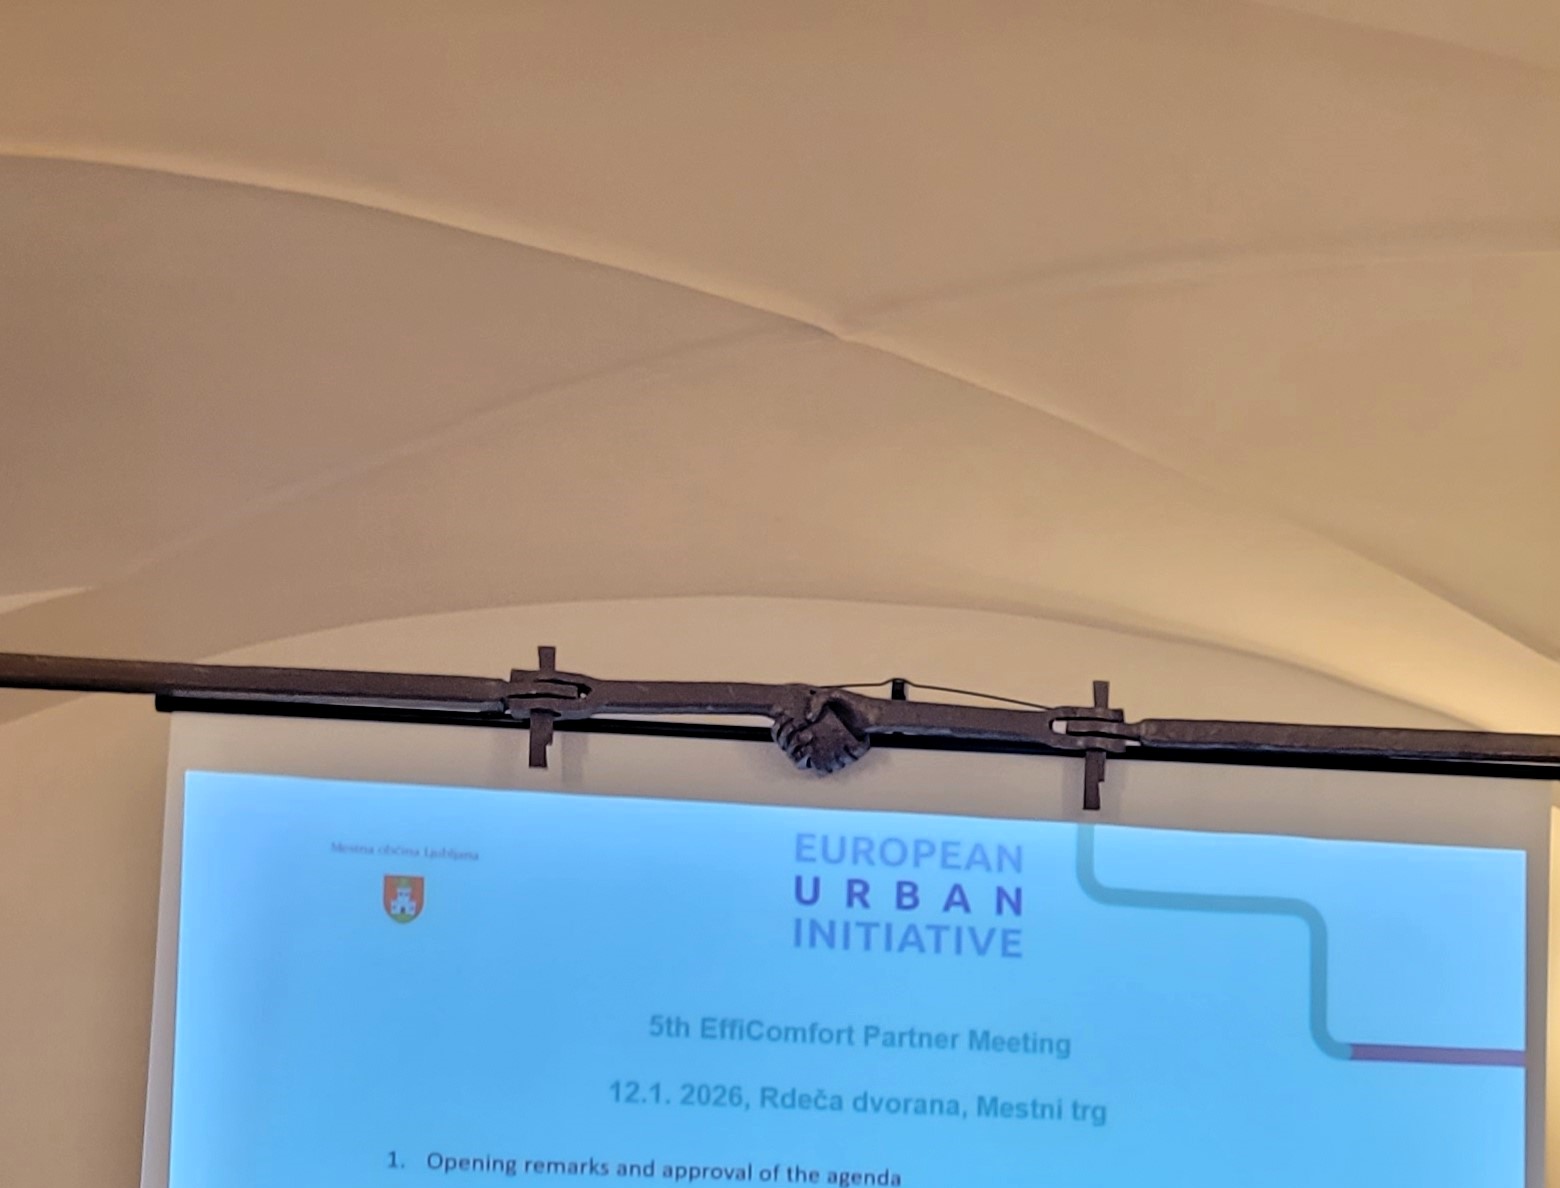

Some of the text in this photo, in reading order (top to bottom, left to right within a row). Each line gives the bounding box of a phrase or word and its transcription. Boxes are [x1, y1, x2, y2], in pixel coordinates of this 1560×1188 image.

[794, 833, 1024, 874] EUROPEAN
[794, 875, 1024, 917] URBAN
[792, 917, 1024, 958] INITIATIVE
[649, 1014, 1072, 1059] 5th EffiComfort Partner Meeting
[609, 1081, 1107, 1126] 12.1. 2026, Rdeča dvorana, Mestni trg
[387, 1151, 405, 1169] 1.
[426, 1152, 518, 1177] Opening
[524, 1156, 609, 1176] remarks
[617, 1157, 655, 1178] and
[662, 1161, 753, 1184] approval
[759, 1163, 781, 1183] of
[787, 1166, 819, 1184] the
